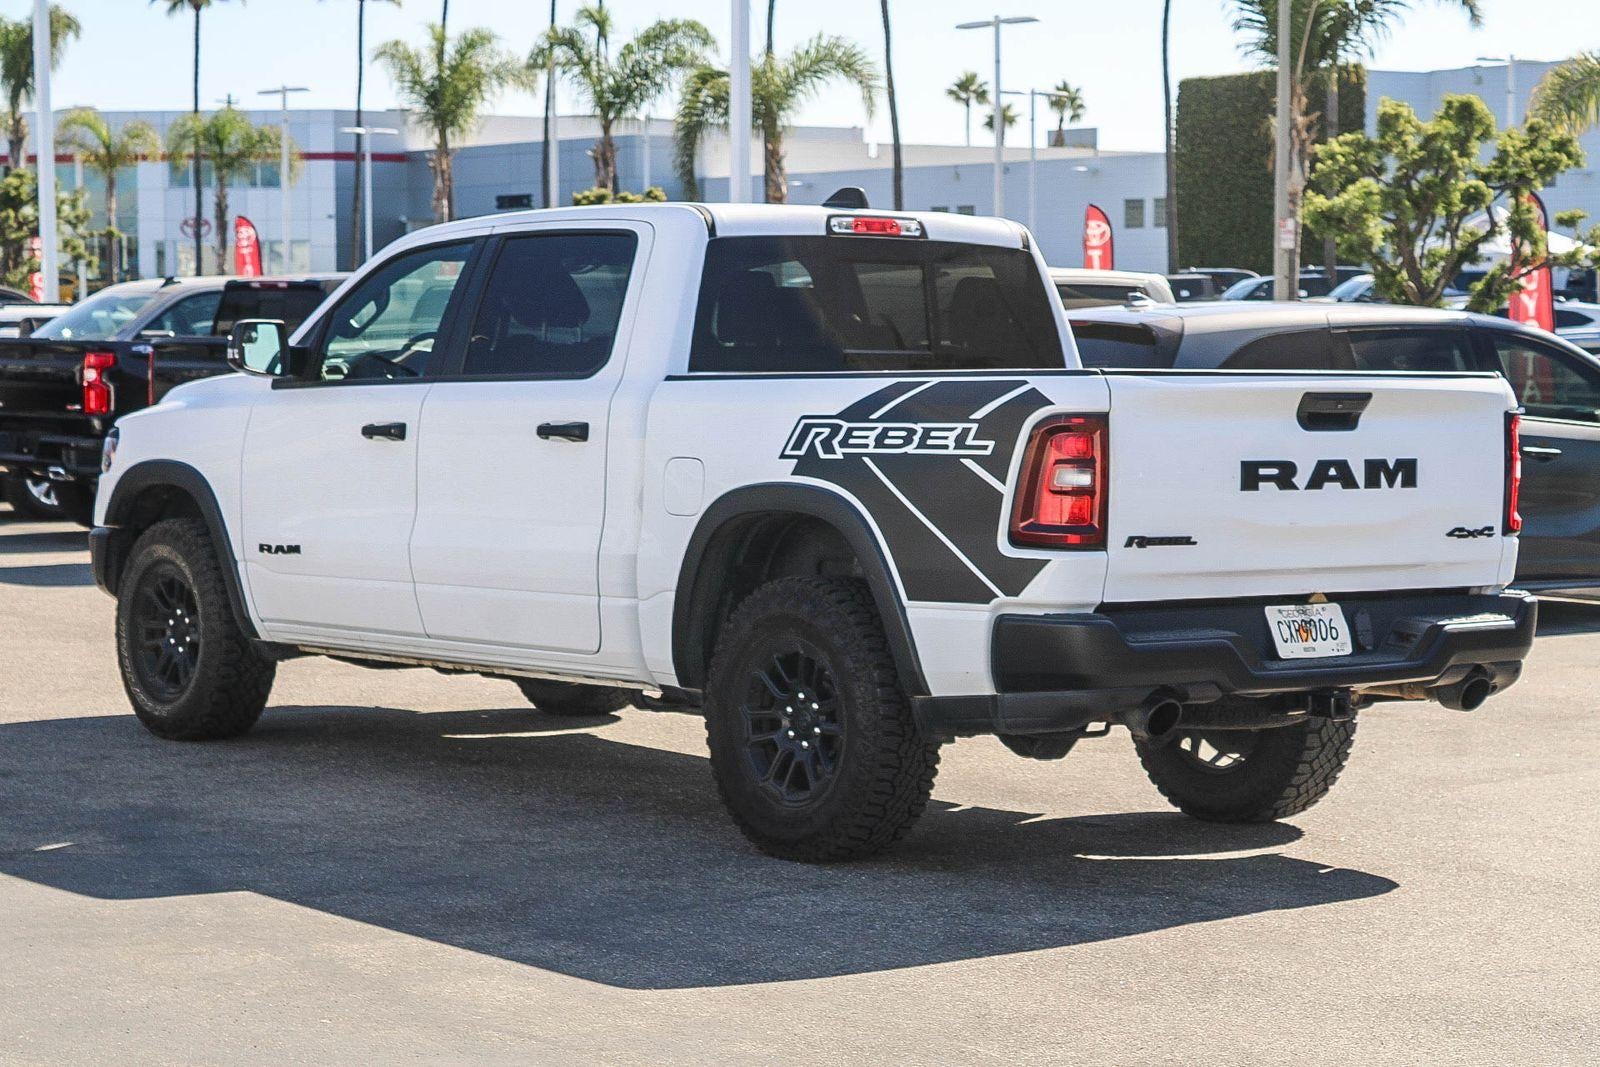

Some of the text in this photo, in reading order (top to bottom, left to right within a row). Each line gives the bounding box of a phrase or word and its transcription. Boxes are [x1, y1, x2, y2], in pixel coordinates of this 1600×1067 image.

[783, 418, 996, 460] REBEL
[1240, 458, 1418, 491] RAM
[1123, 535, 1198, 549] REBEL
[1445, 526, 1496, 539] 4x4
[258, 543, 302, 555] RAM
[1277, 617, 1339, 644] CXR9006
